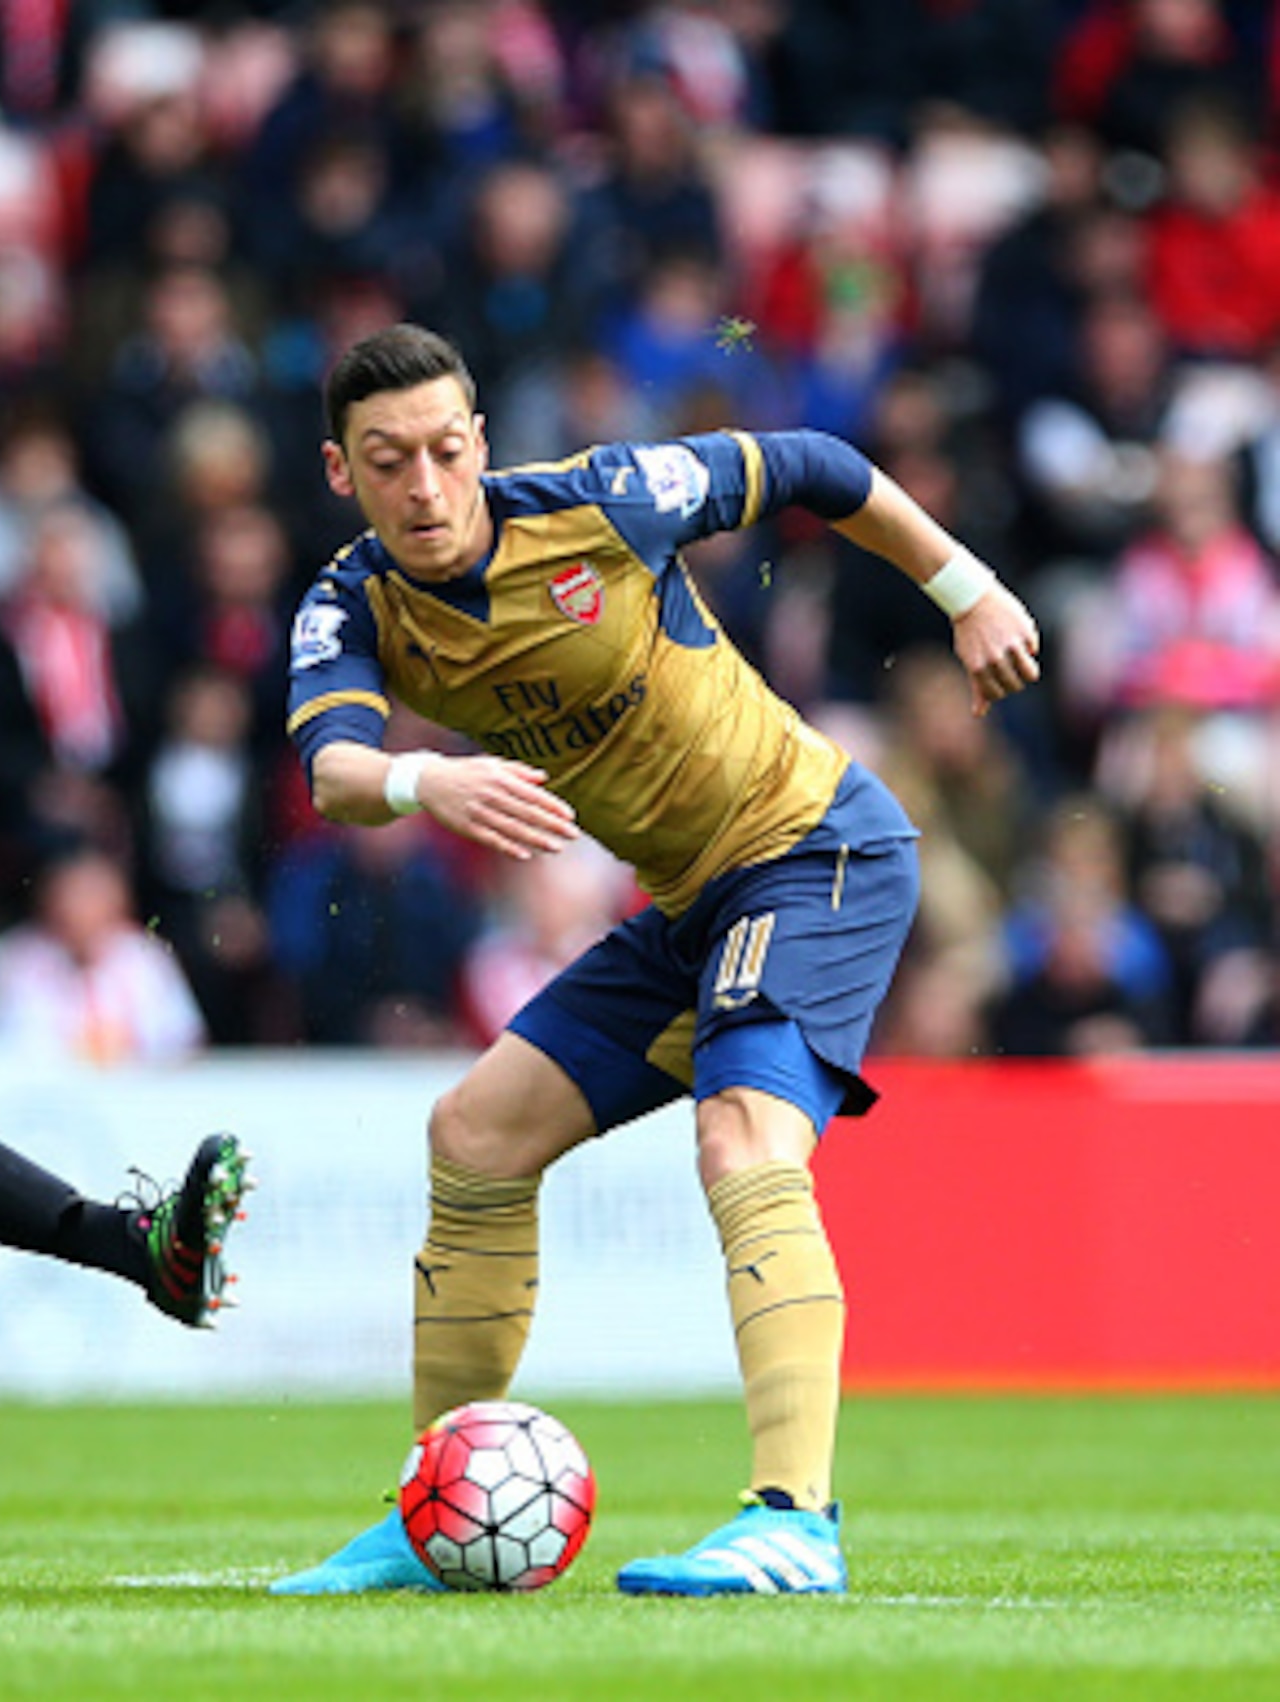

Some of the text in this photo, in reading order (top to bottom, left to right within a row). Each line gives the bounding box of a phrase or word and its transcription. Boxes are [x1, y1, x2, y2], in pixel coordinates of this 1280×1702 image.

[484, 673, 648, 758] mirates
[493, 679, 561, 713] Fly
[714, 911, 776, 993] 11
